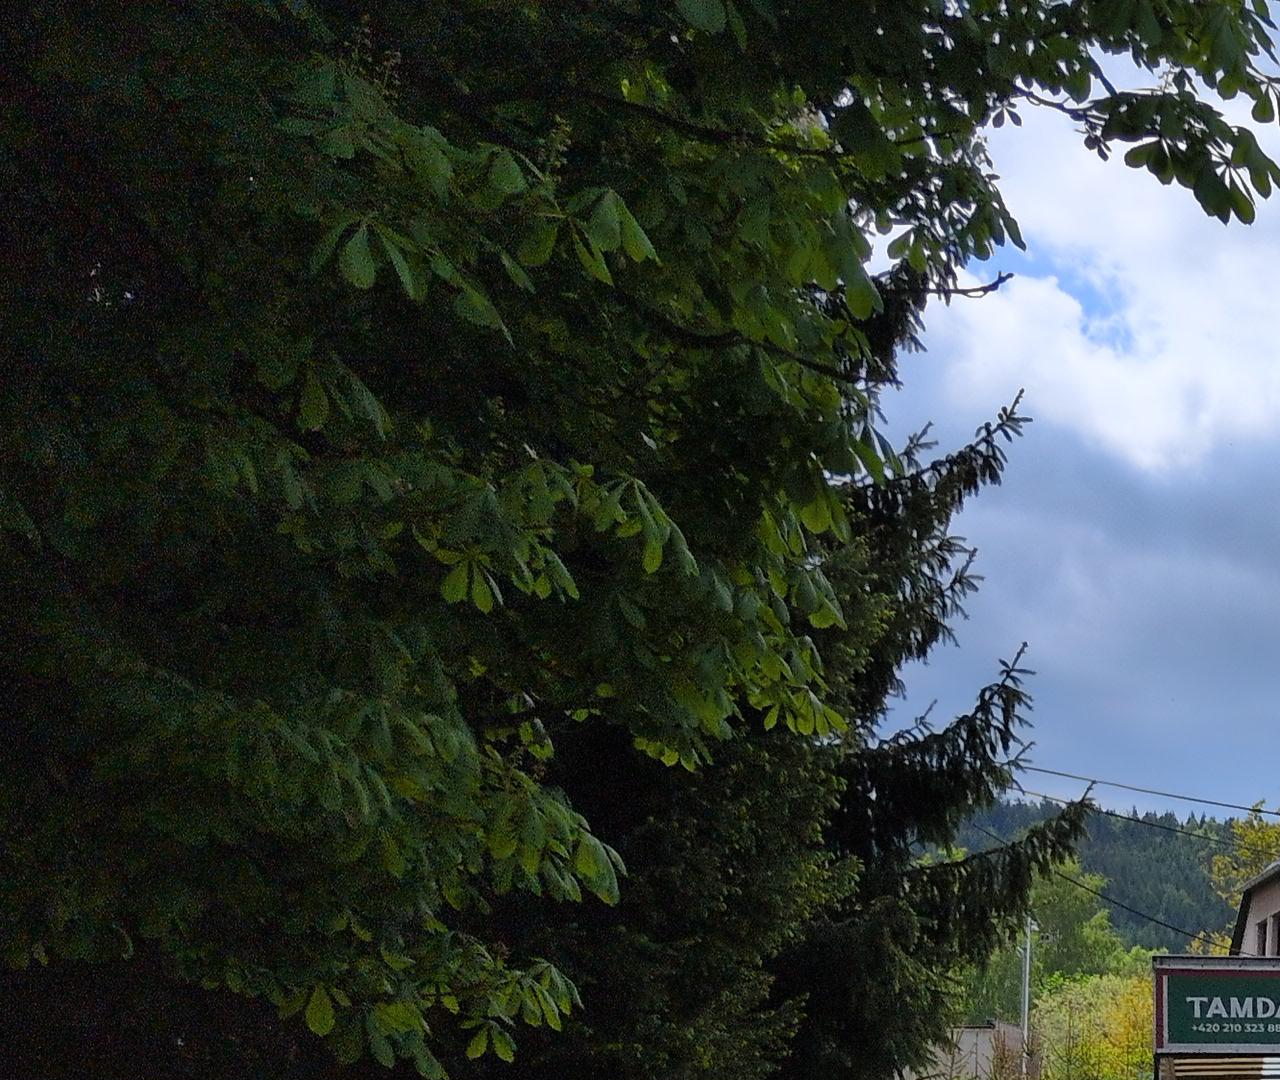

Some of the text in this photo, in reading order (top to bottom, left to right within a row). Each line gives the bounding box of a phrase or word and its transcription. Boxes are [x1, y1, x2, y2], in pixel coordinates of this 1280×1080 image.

[1191, 1023, 1221, 1033] +420
[1222, 1023, 1242, 1033] 210
[1244, 1023, 1265, 1034] 323
